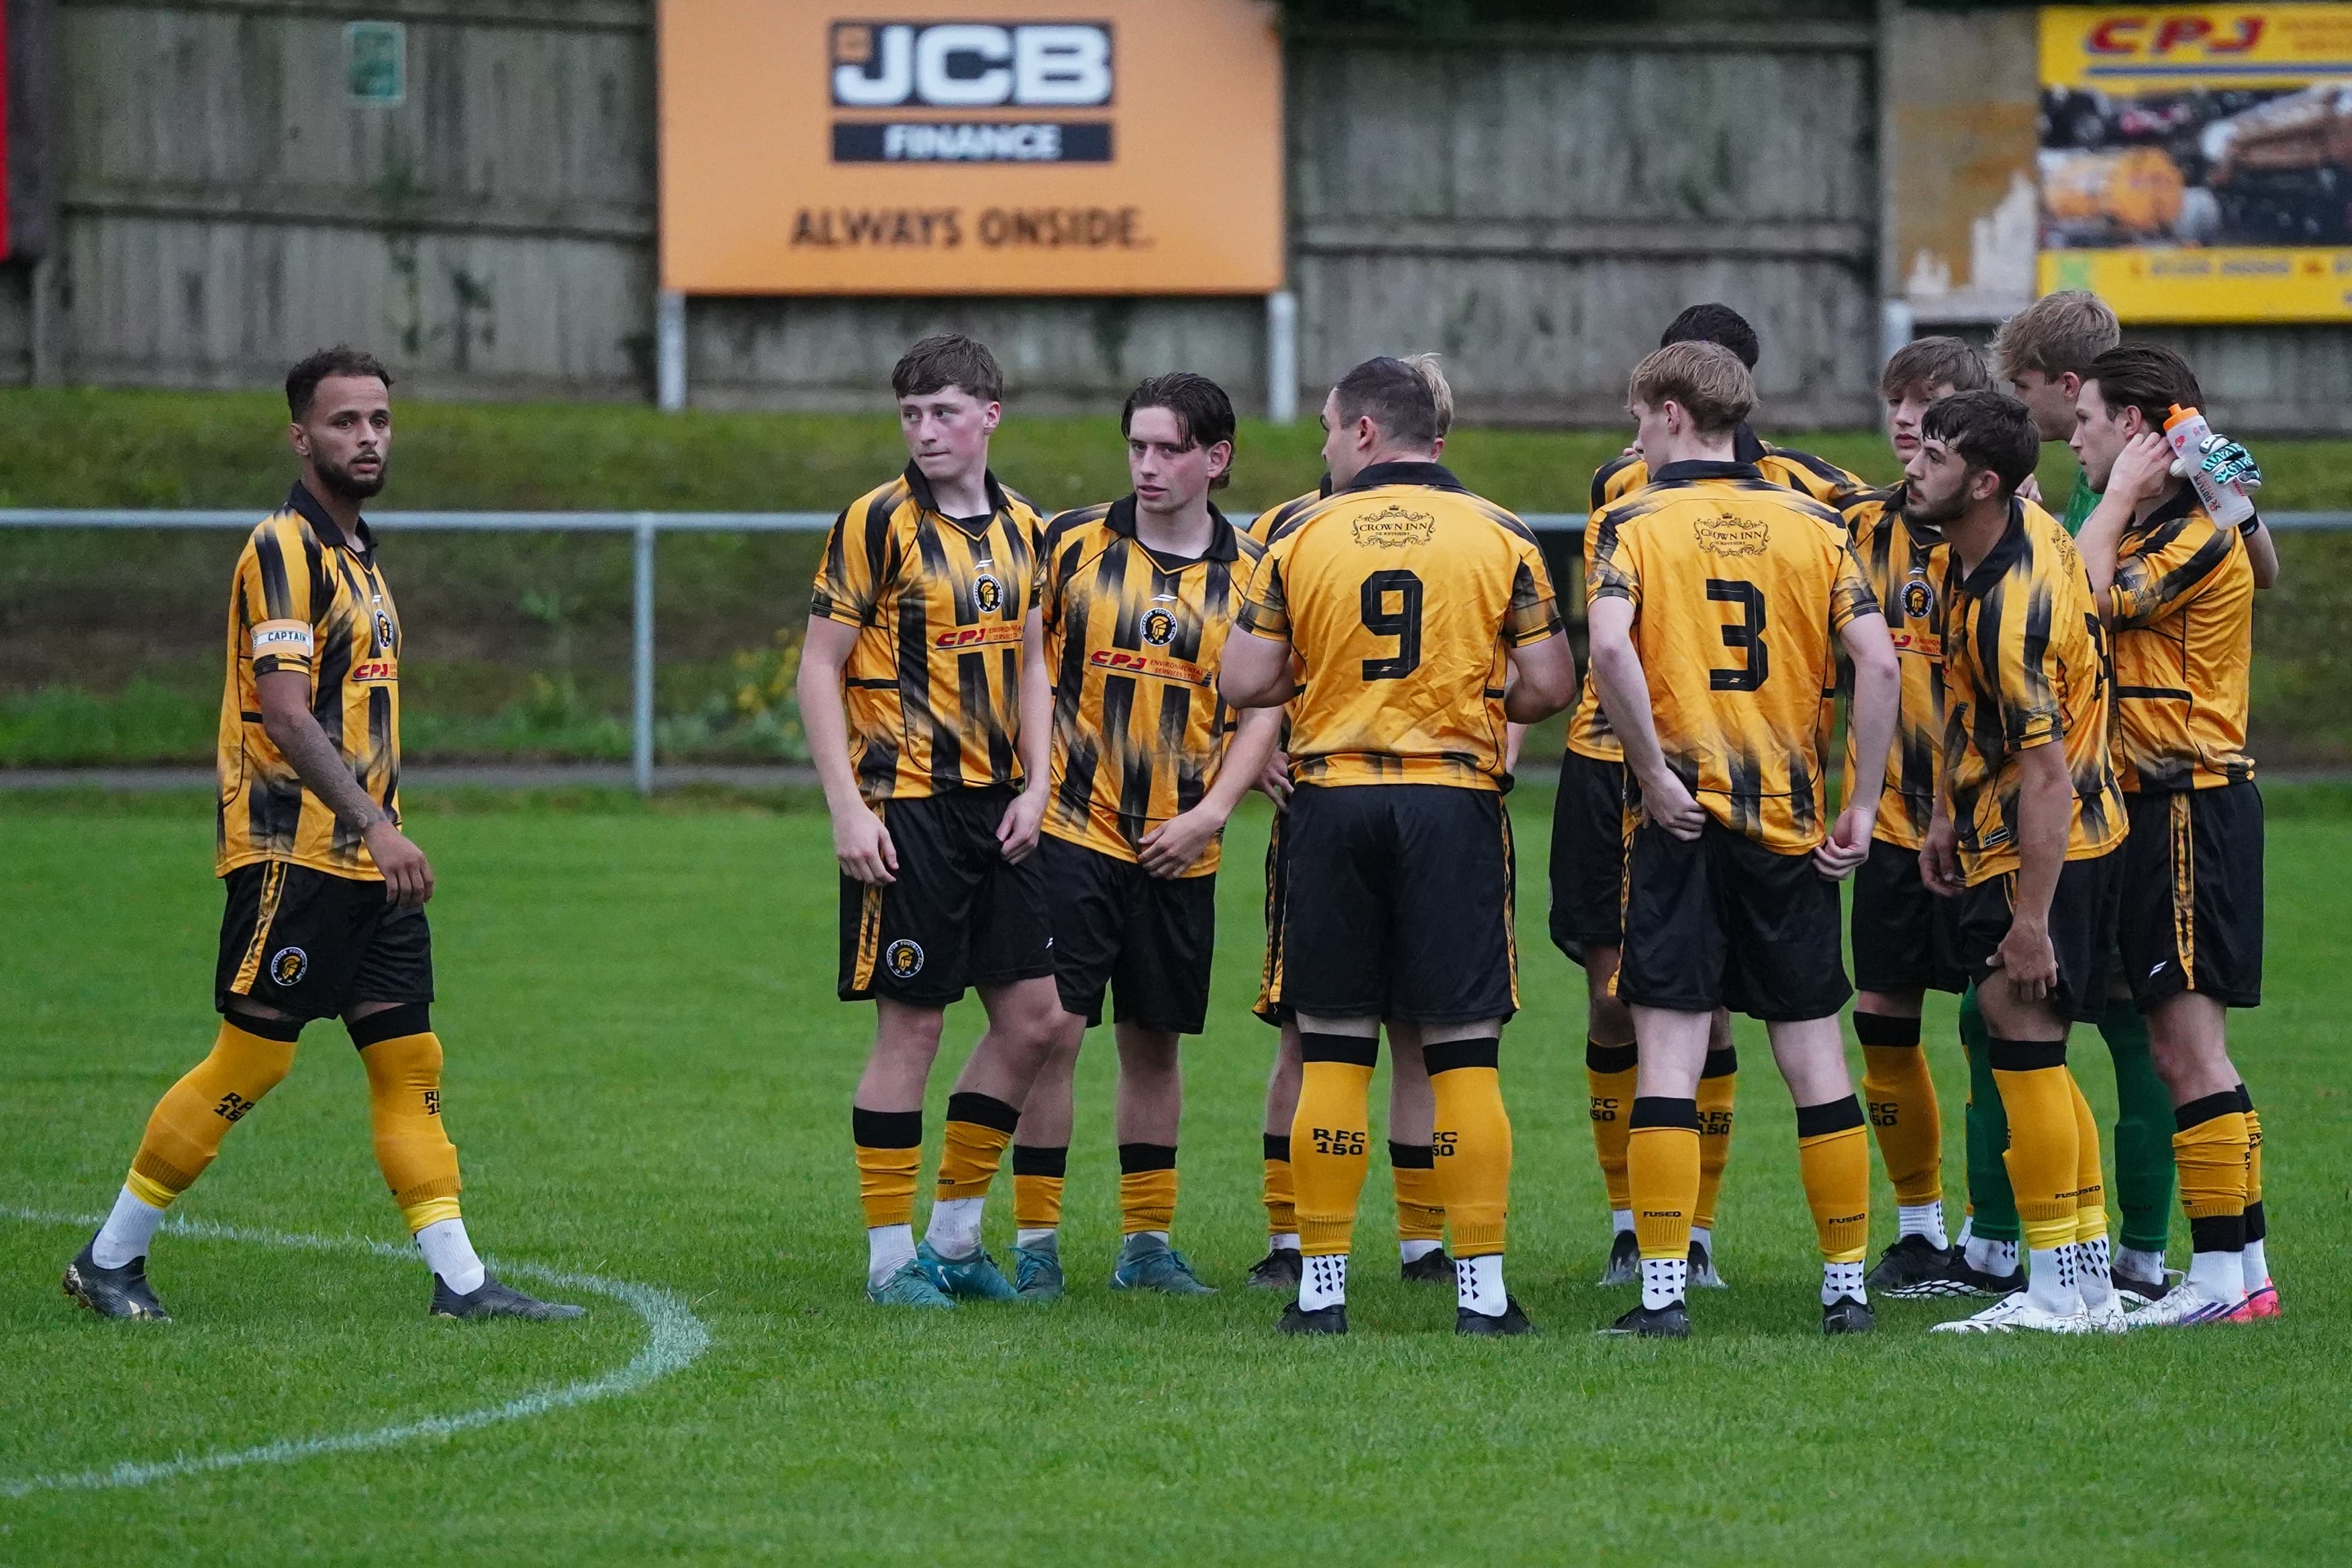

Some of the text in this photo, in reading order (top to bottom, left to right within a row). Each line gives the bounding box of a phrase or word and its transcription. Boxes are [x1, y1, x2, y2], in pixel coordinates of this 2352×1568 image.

[2086, 15, 2266, 54] CPJ
[832, 25, 1112, 105] JCB
[883, 125, 1061, 160] FINANCE
[789, 207, 959, 248] ALWAYS
[1359, 524, 1402, 532] CROWN
[1700, 529, 1762, 540] CROWN INN
[1361, 569, 1423, 681] 9
[268, 632, 307, 642] CAPTAIN
[936, 628, 986, 646] CPJ
[1706, 579, 1769, 691] 3
[1091, 650, 1204, 677] CPJ ENVIRONMENTAL
[353, 664, 389, 679] CPJ
[1154, 668, 1183, 678] SERVICES
[1591, 1095, 1618, 1108] FC
[1867, 1101, 1898, 1114] FC
[1590, 1108, 1616, 1120] 50
[1869, 1114, 1898, 1126] 50
[1313, 1128, 1365, 1142] RFC
[1433, 1132, 1458, 1143] FC
[1316, 1141, 1363, 1155] 150
[1433, 1144, 1455, 1156] 50
[1829, 1213, 1865, 1224] FUSED
